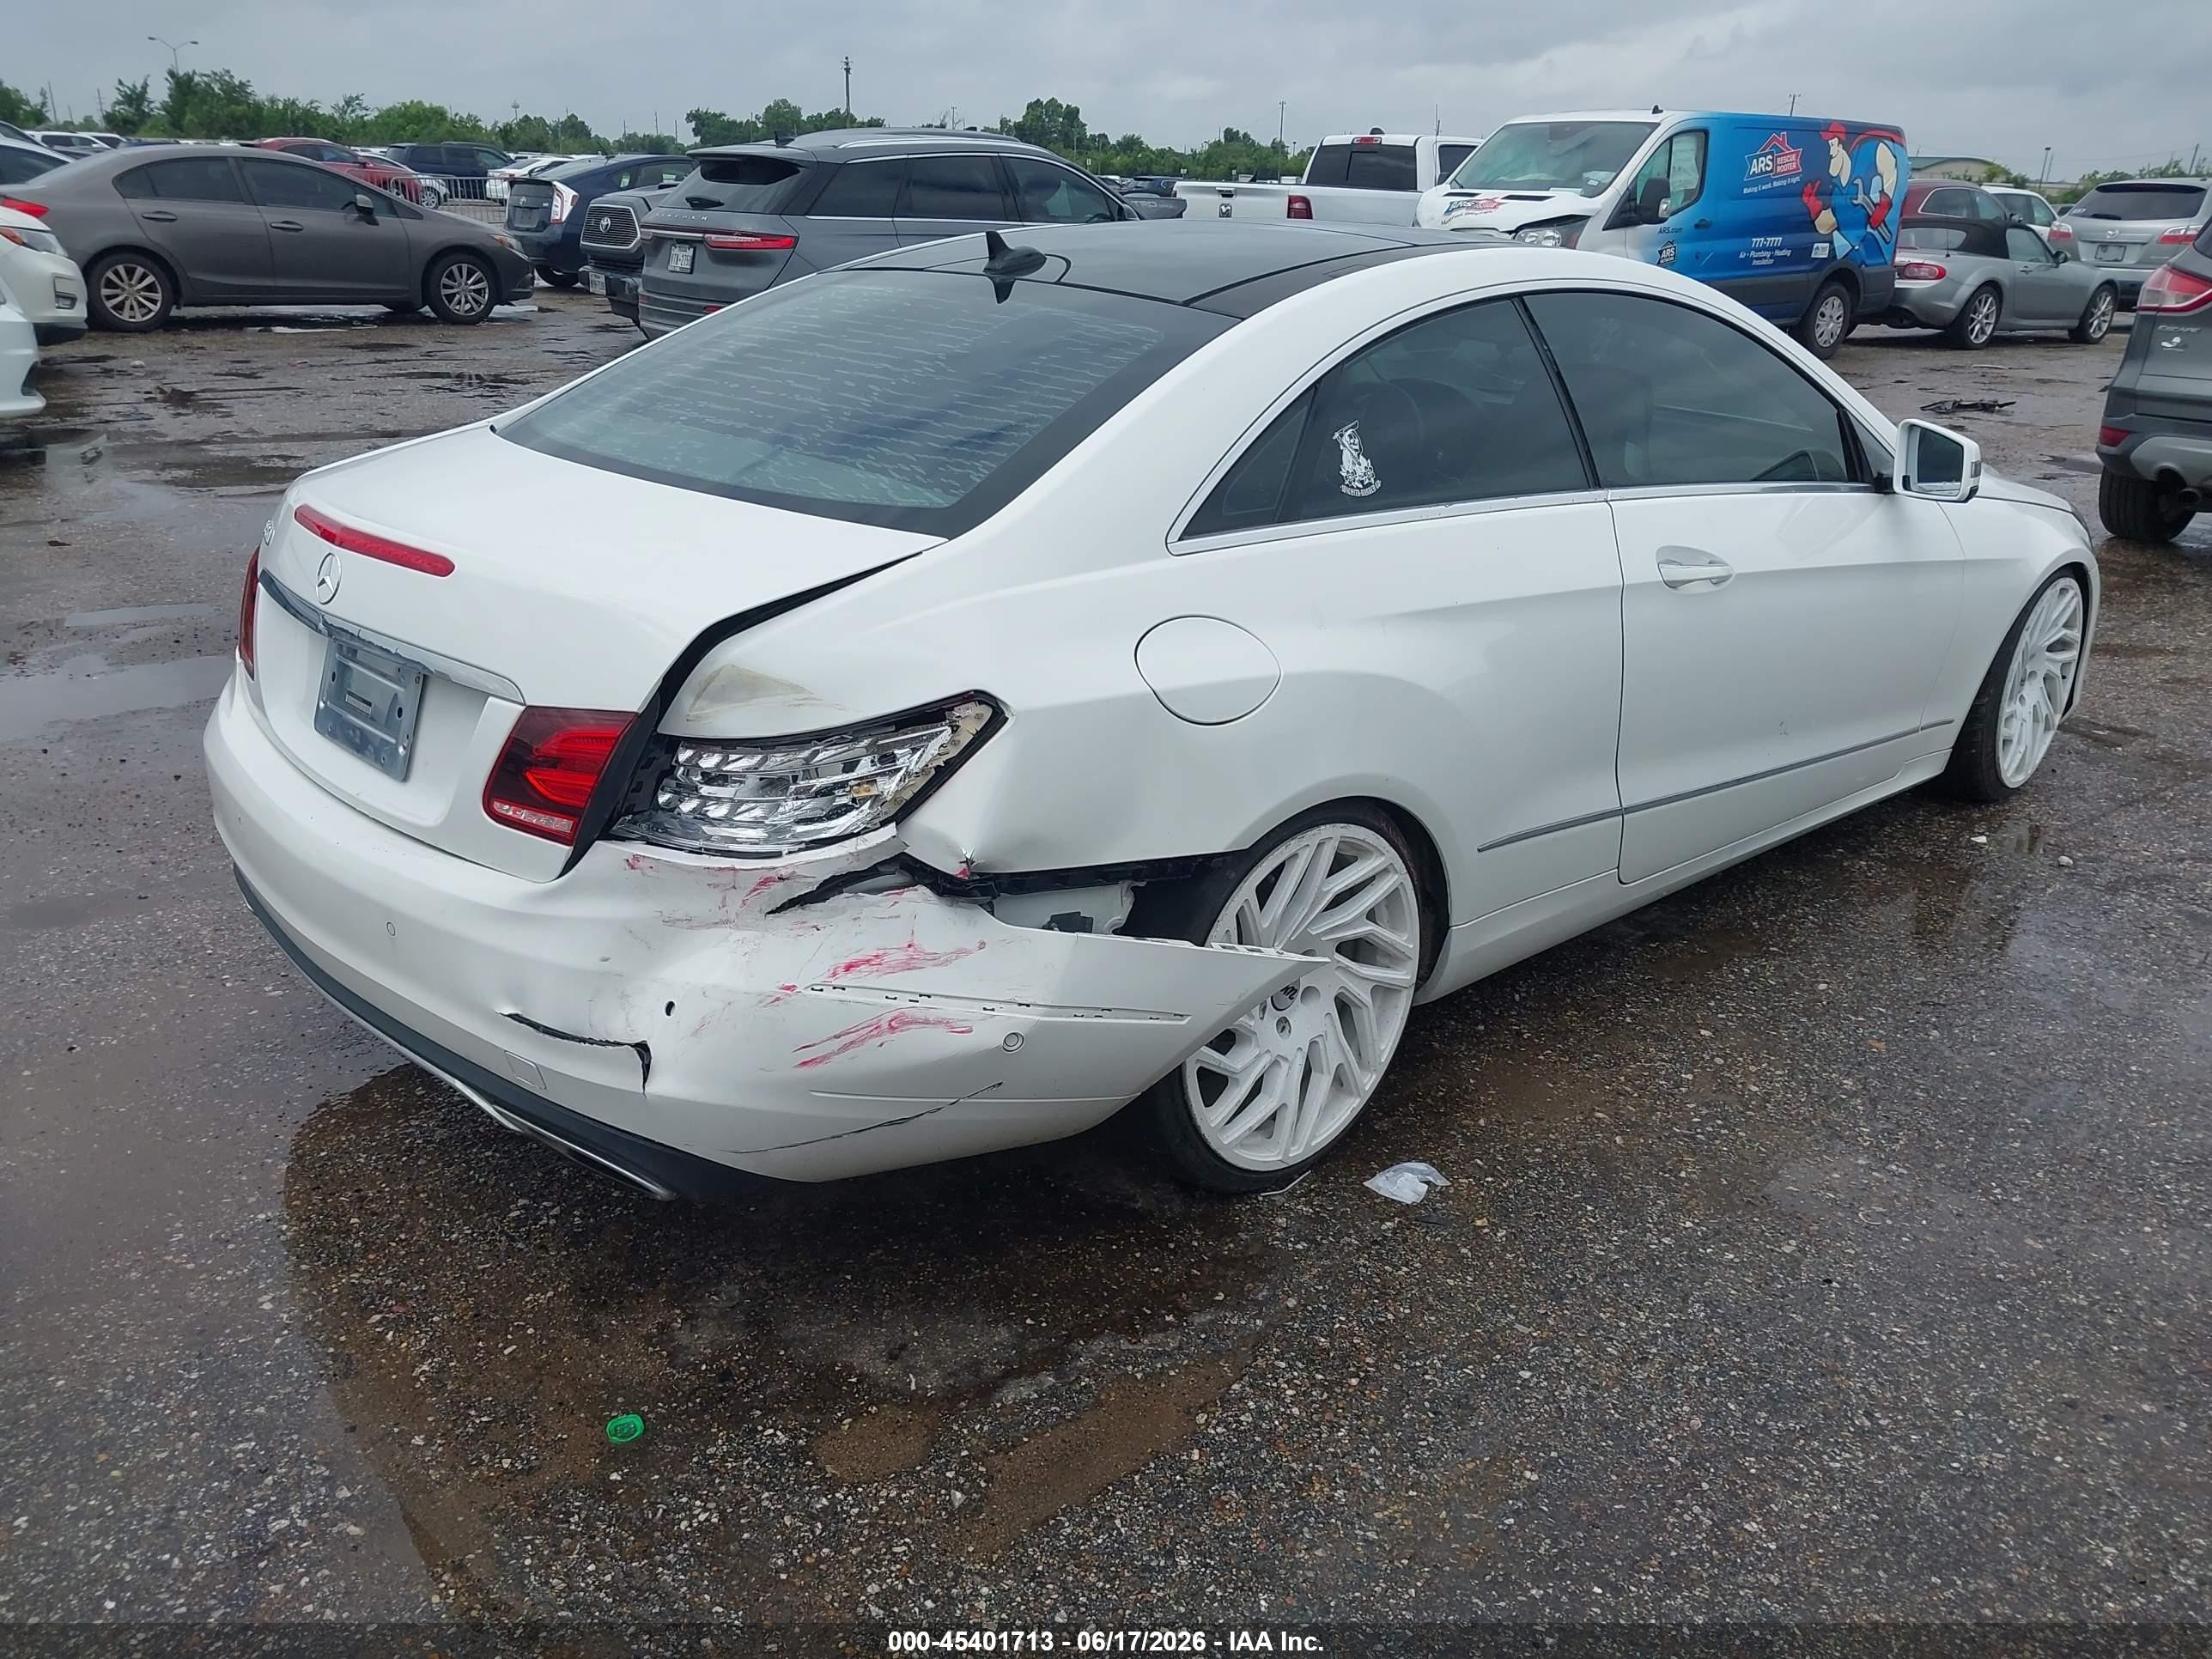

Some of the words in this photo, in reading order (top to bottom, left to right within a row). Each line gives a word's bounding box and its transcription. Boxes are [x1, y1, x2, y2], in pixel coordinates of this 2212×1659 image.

[1749, 155, 1773, 175] ARS
[1777, 154, 1796, 165] RESCUE
[1777, 162, 1796, 173] ROOTER
[1751, 237, 1783, 248] 777-7777
[1661, 247, 1675, 259] ARS
[1750, 250, 1771, 258] Plumbing
[1774, 249, 1792, 258] Heating
